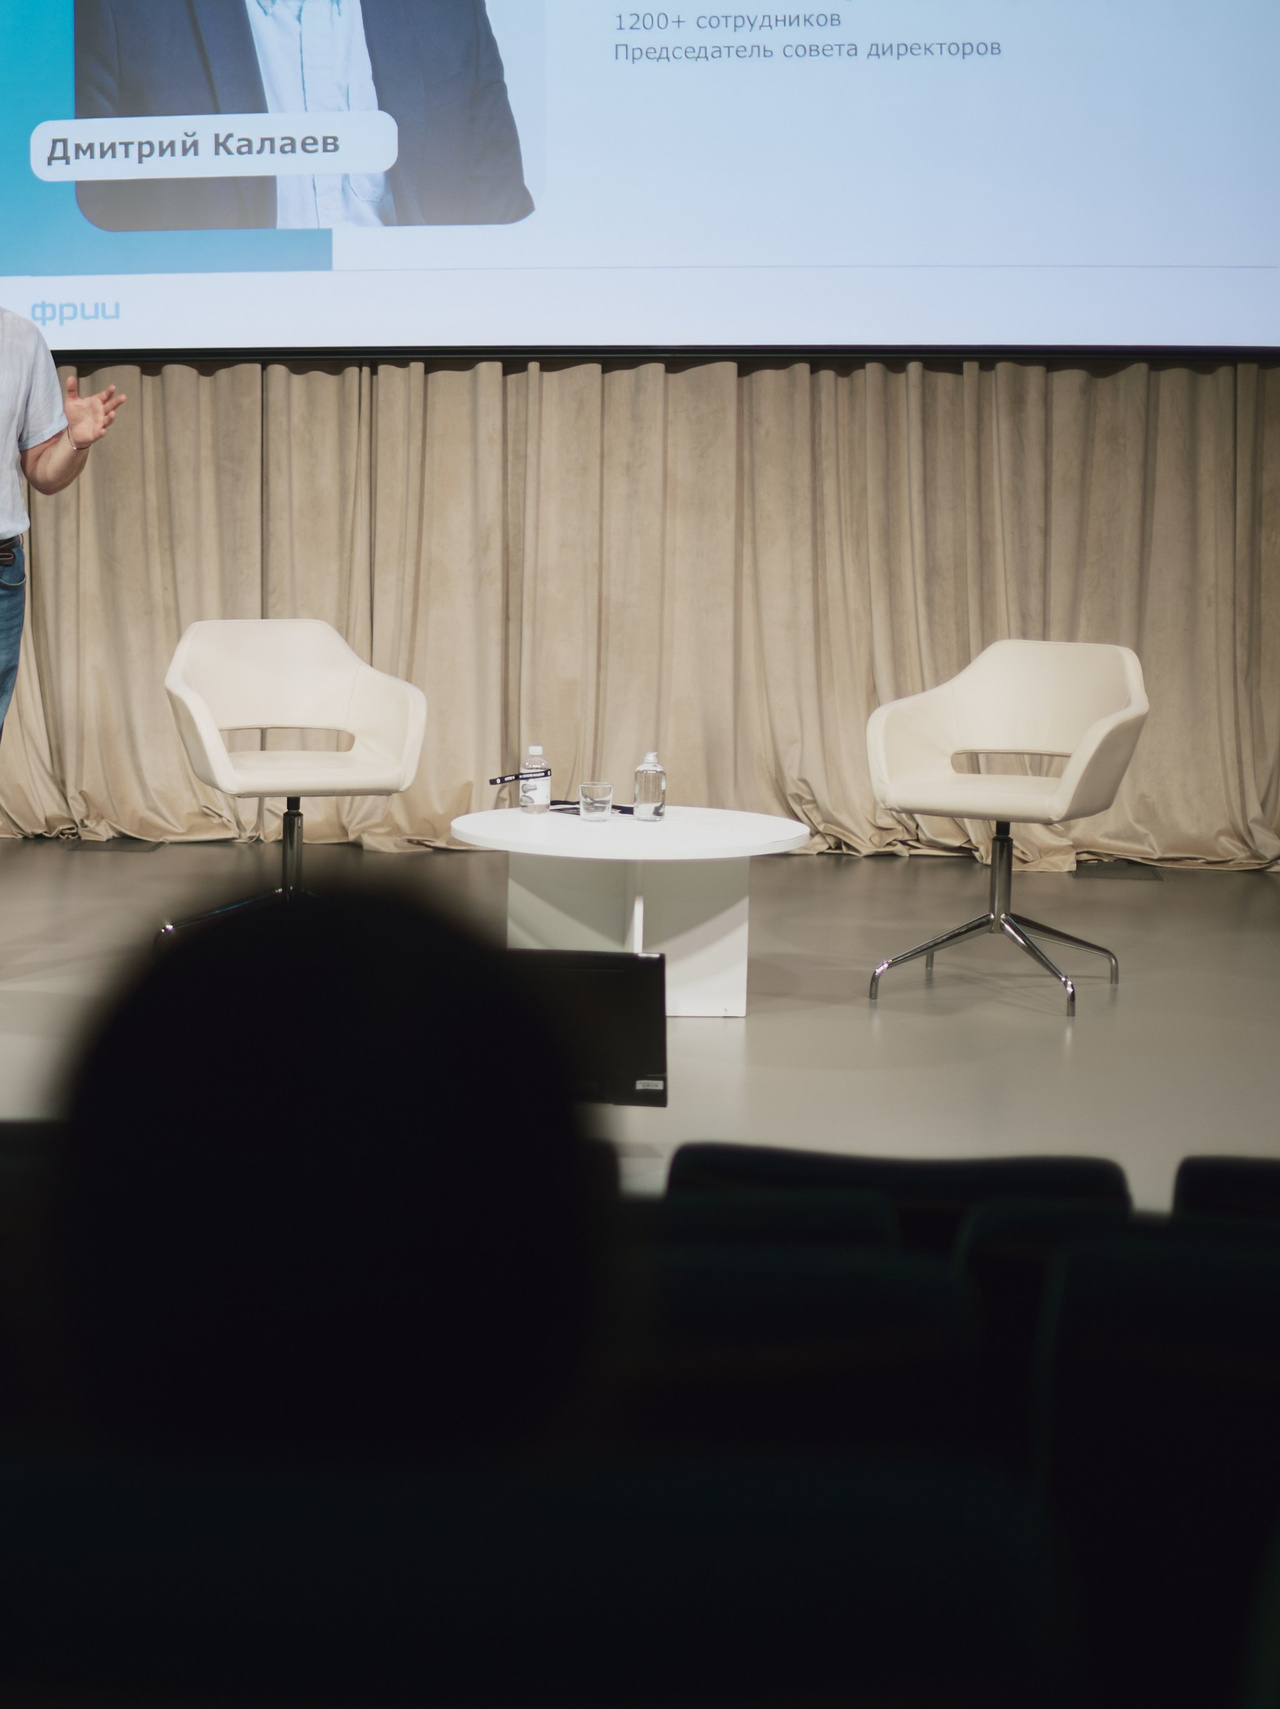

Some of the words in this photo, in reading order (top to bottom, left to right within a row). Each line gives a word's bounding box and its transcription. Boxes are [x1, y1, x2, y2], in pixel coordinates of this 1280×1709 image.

[615, 12, 686, 31] 1200+
[696, 12, 842, 32] сотрудников
[614, 42, 774, 64] Председатель
[782, 40, 858, 58] совета
[866, 39, 1002, 60] директоров
[46, 131, 200, 166] Дмитрий
[213, 131, 340, 157] Калаев
